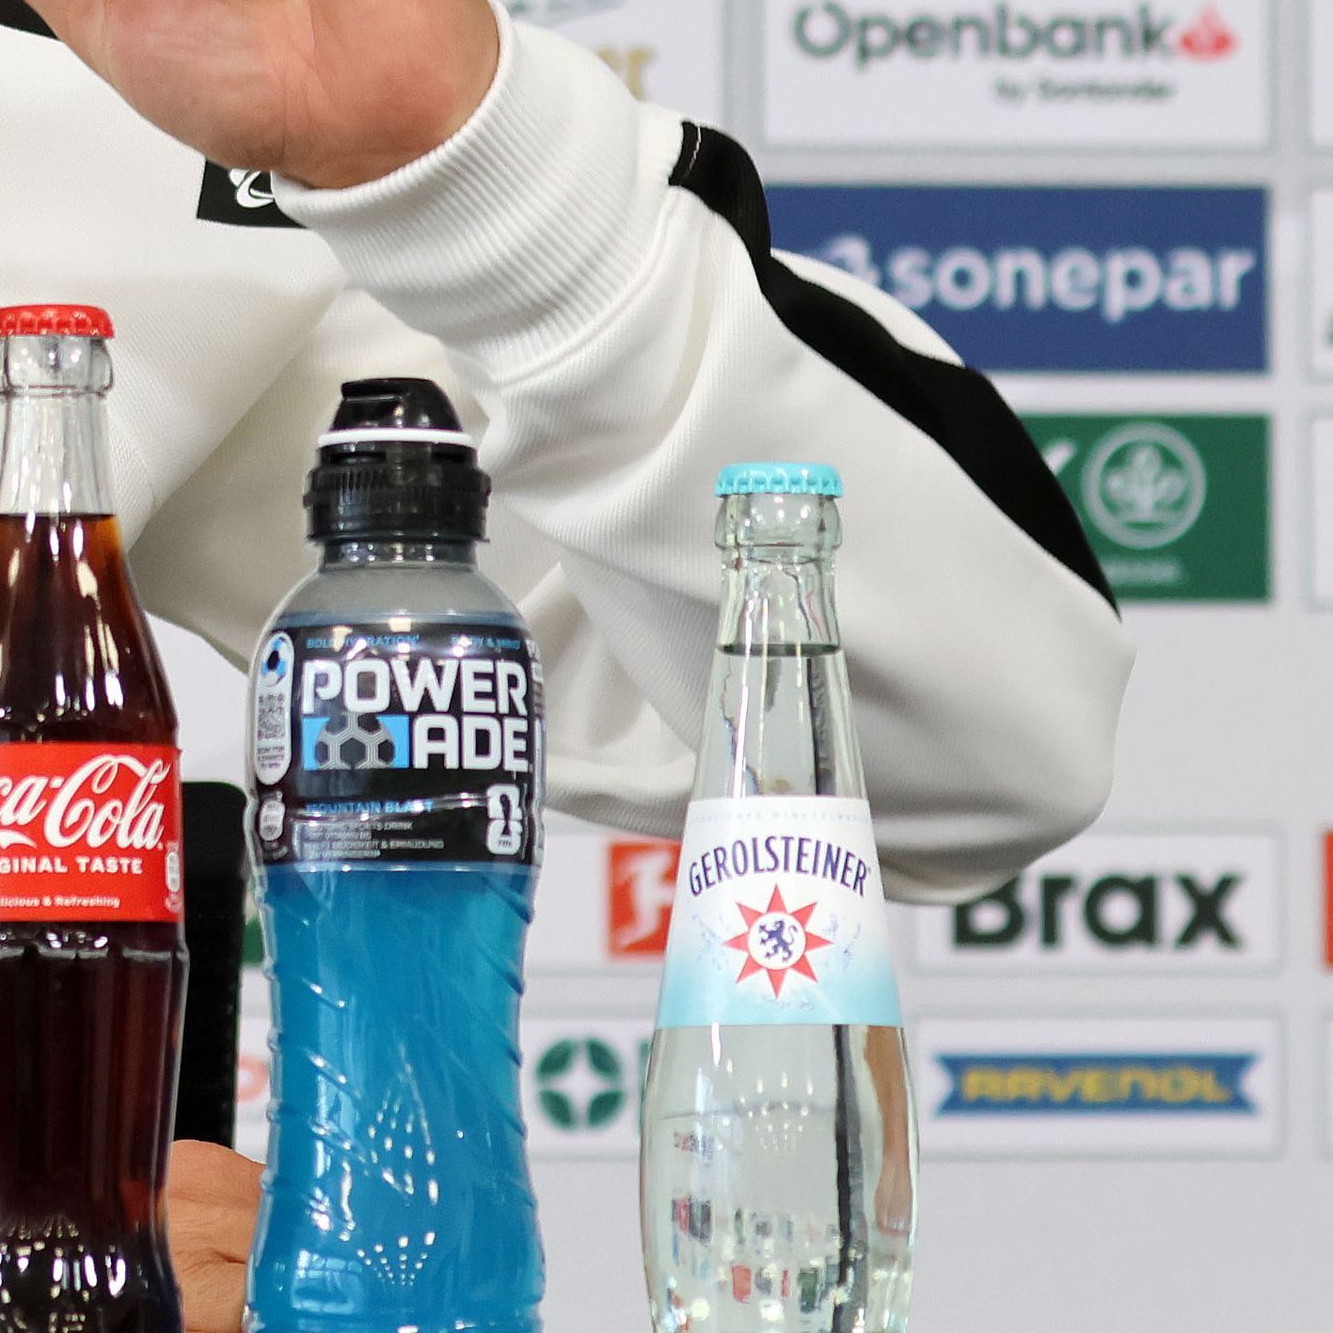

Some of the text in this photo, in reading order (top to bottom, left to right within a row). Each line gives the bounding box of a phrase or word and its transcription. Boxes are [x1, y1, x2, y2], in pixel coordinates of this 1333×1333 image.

[794, 0, 1175, 68] Openbank
[888, 246, 1257, 325] sonepar
[301, 658, 529, 716] POWER
[412, 714, 530, 773] ADE
[75, 855, 144, 875] TASTE
[689, 835, 866, 899] GEROLSTEINER
[42, 895, 52, 907] &
[55, 895, 121, 909] Refreshing
[951, 864, 1245, 952] Brax
[960, 1064, 1232, 1106] RAVENOL
